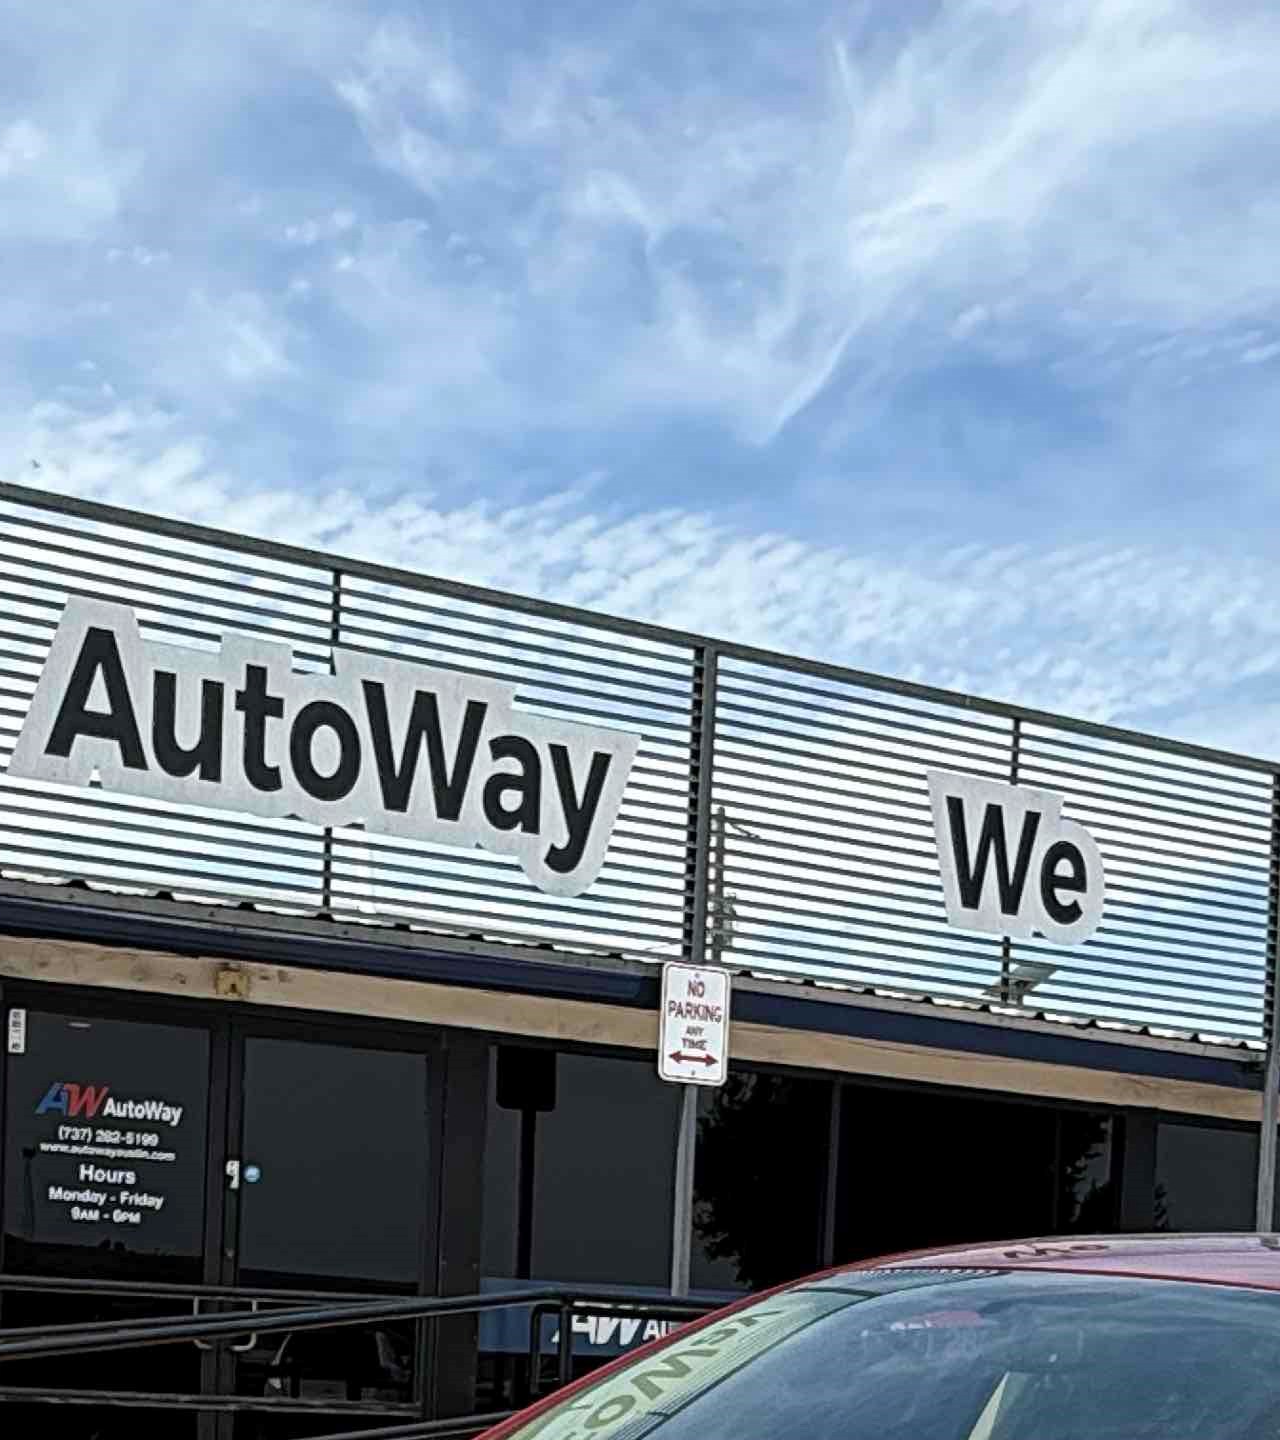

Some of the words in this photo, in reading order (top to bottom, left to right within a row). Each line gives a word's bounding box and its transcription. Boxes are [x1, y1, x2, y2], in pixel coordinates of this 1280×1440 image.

[44, 626, 613, 874] AutoWay
[946, 795, 1088, 926] We
[686, 980, 706, 998] NO
[668, 1000, 722, 1025] PARKING
[685, 1024, 705, 1037] ANY
[681, 1037, 708, 1051] TIME
[34, 1081, 109, 1120] AW
[102, 1097, 183, 1127] AutoWay
[58, 1125, 93, 1142] (737)
[79, 1164, 136, 1185] Hours
[48, 1186, 106, 1206] Monday
[120, 1191, 164, 1210] Friday
